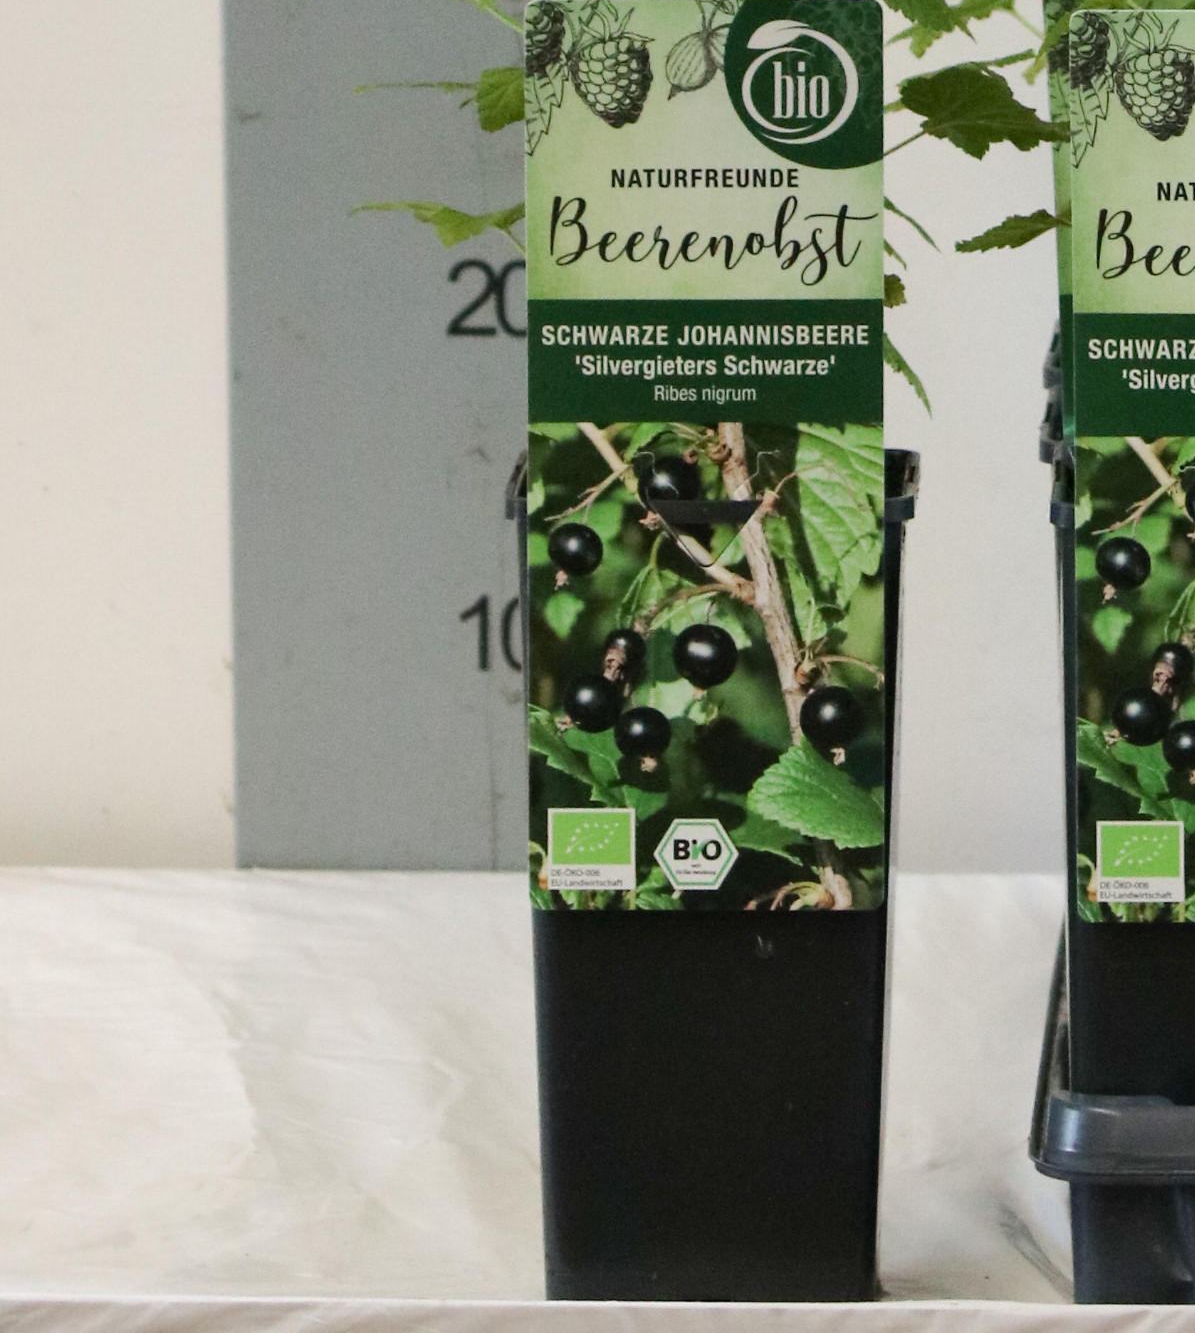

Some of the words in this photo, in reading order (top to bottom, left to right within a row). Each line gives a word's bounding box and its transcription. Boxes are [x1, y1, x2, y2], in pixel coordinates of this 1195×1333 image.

[773, 61, 830, 119] bio
[611, 168, 799, 188] NATURFREUNDE
[550, 196, 878, 286] Beerenobst
[447, 259, 527, 336] 20
[541, 325, 668, 346] SCHWARZE
[677, 324, 869, 346] JOHANNISBEERE
[576, 355, 717, 378] 'Silvergieters
[724, 355, 835, 375] Schwarze'
[654, 385, 697, 402] Ribes
[702, 385, 756, 406] nigrum
[551, 879, 623, 887] EU-Landwirtschaft
[1100, 891, 1172, 899] EU-Landwirtschaft
